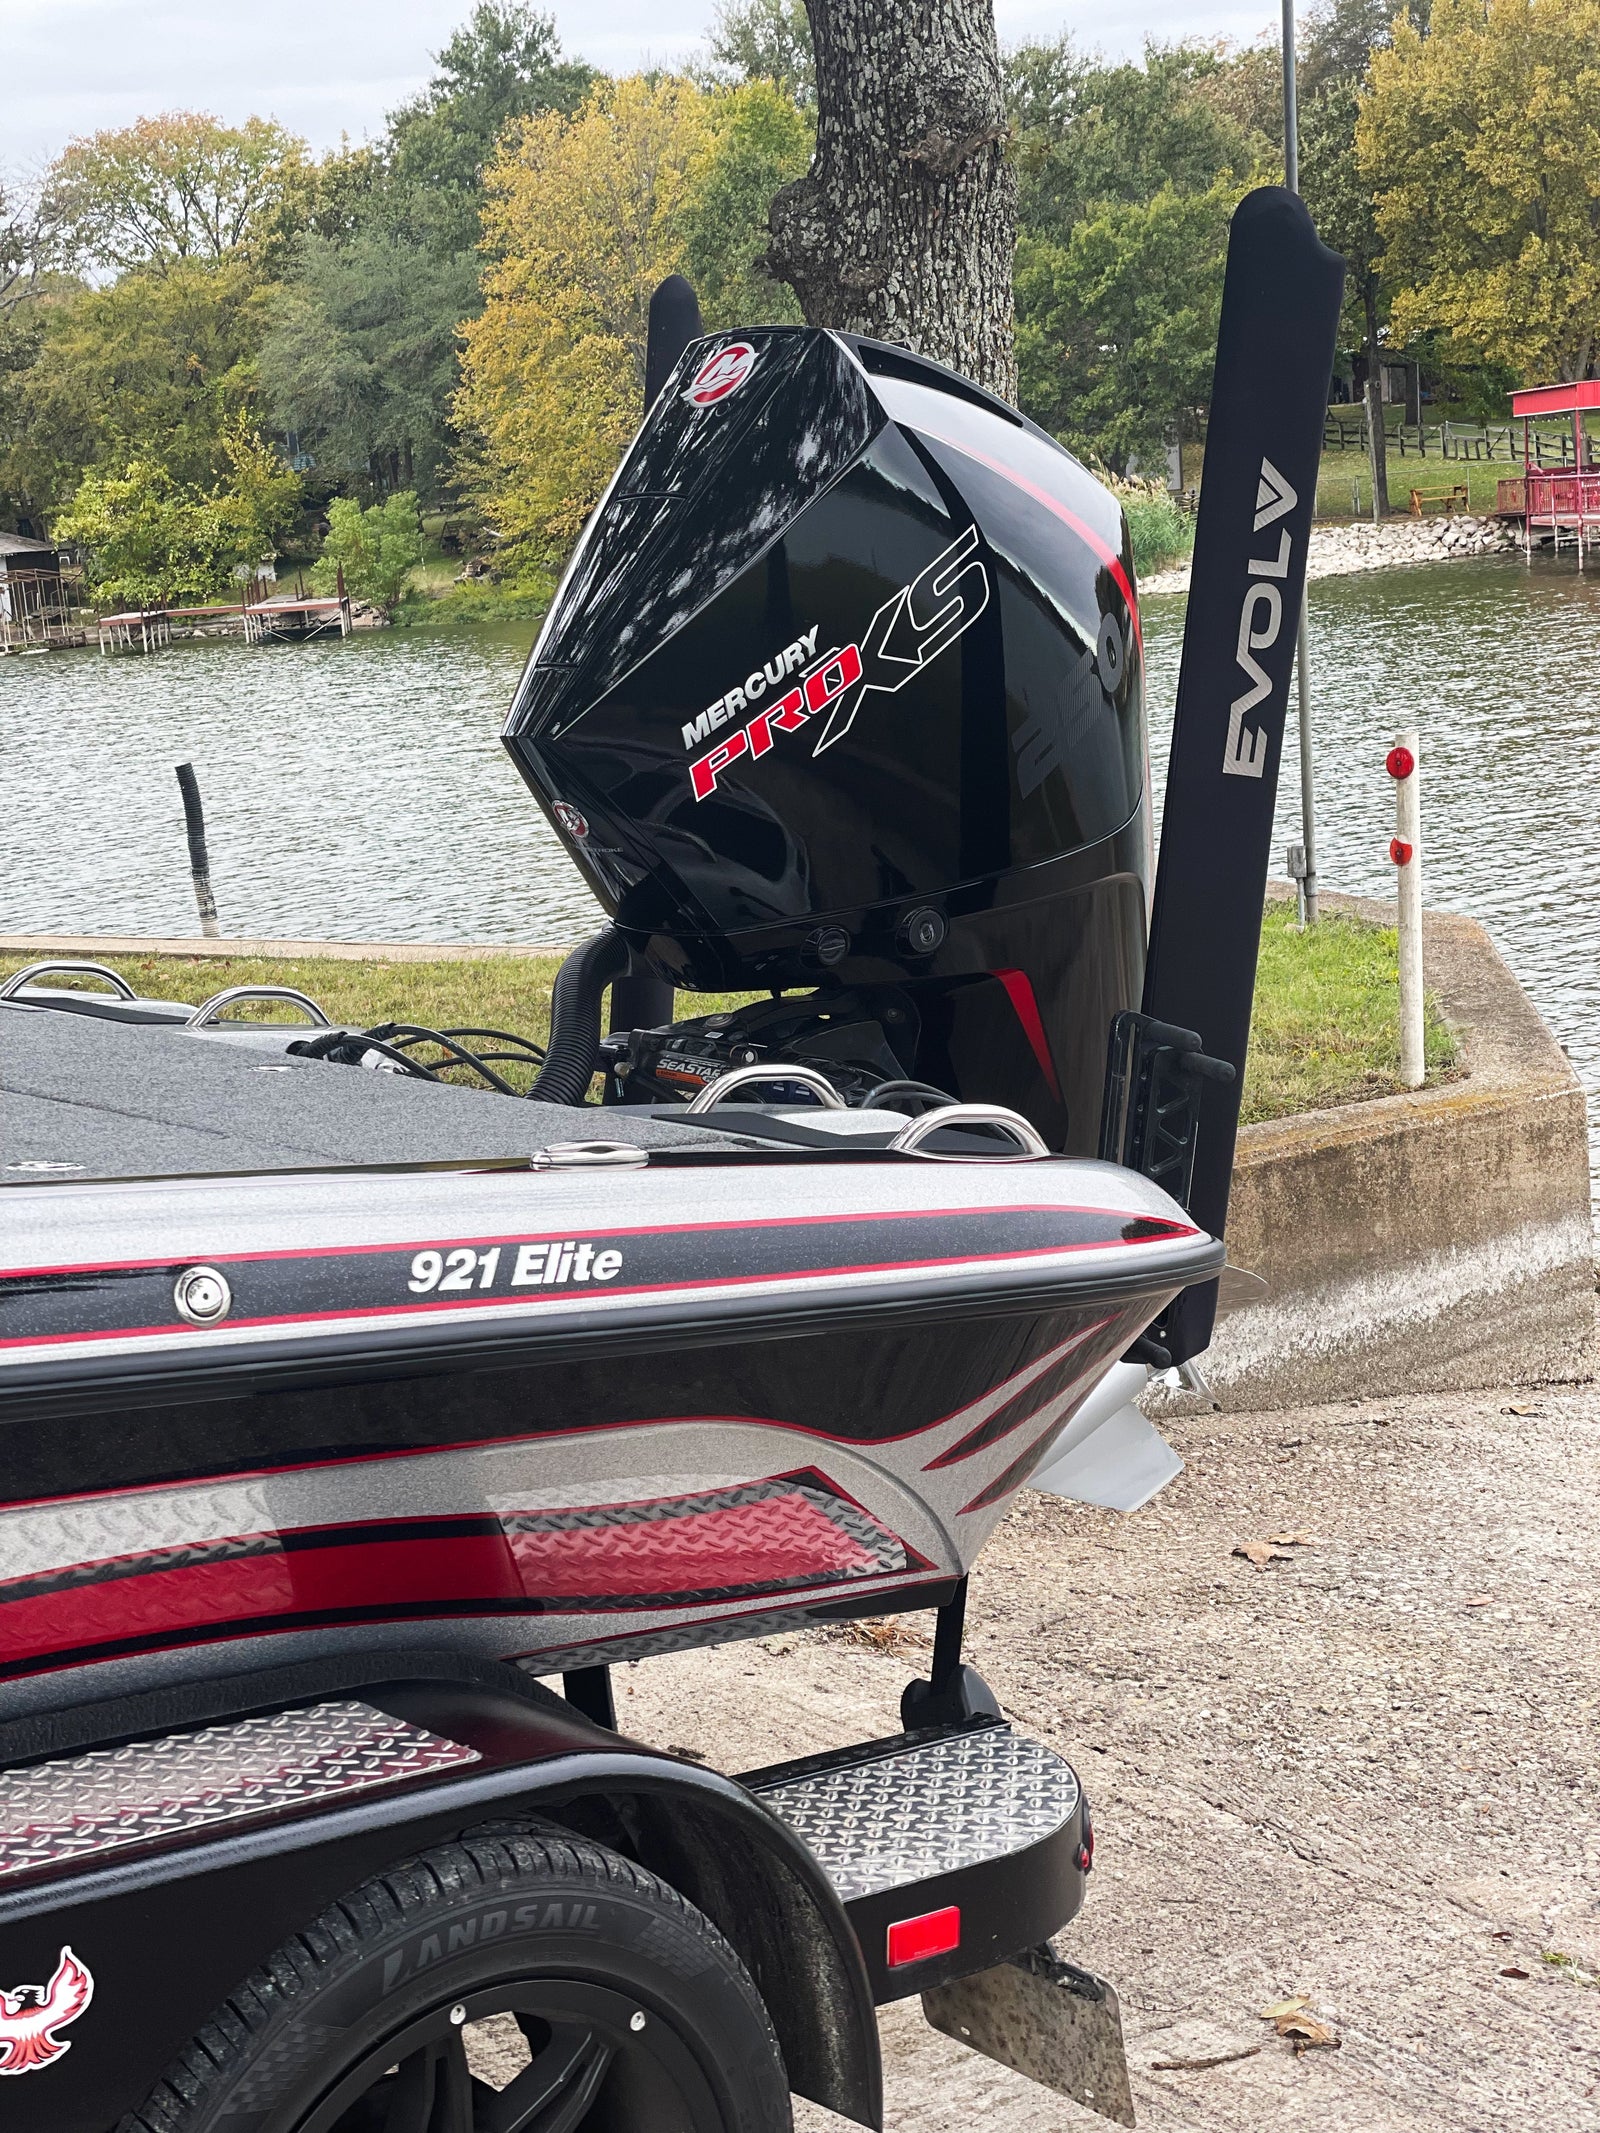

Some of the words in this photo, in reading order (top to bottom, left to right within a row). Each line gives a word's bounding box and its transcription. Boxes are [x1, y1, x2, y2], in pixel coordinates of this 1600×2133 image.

[681, 624, 819, 750] MERCURY
[689, 643, 863, 802] PRO
[799, 524, 989, 757] XS
[1222, 456, 1298, 778] EVOLV
[1011, 612, 1124, 800] 250
[407, 1248, 501, 1293] 921
[511, 1241, 622, 1286] Elite
[381, 1902, 601, 1995] LANDSAIL
